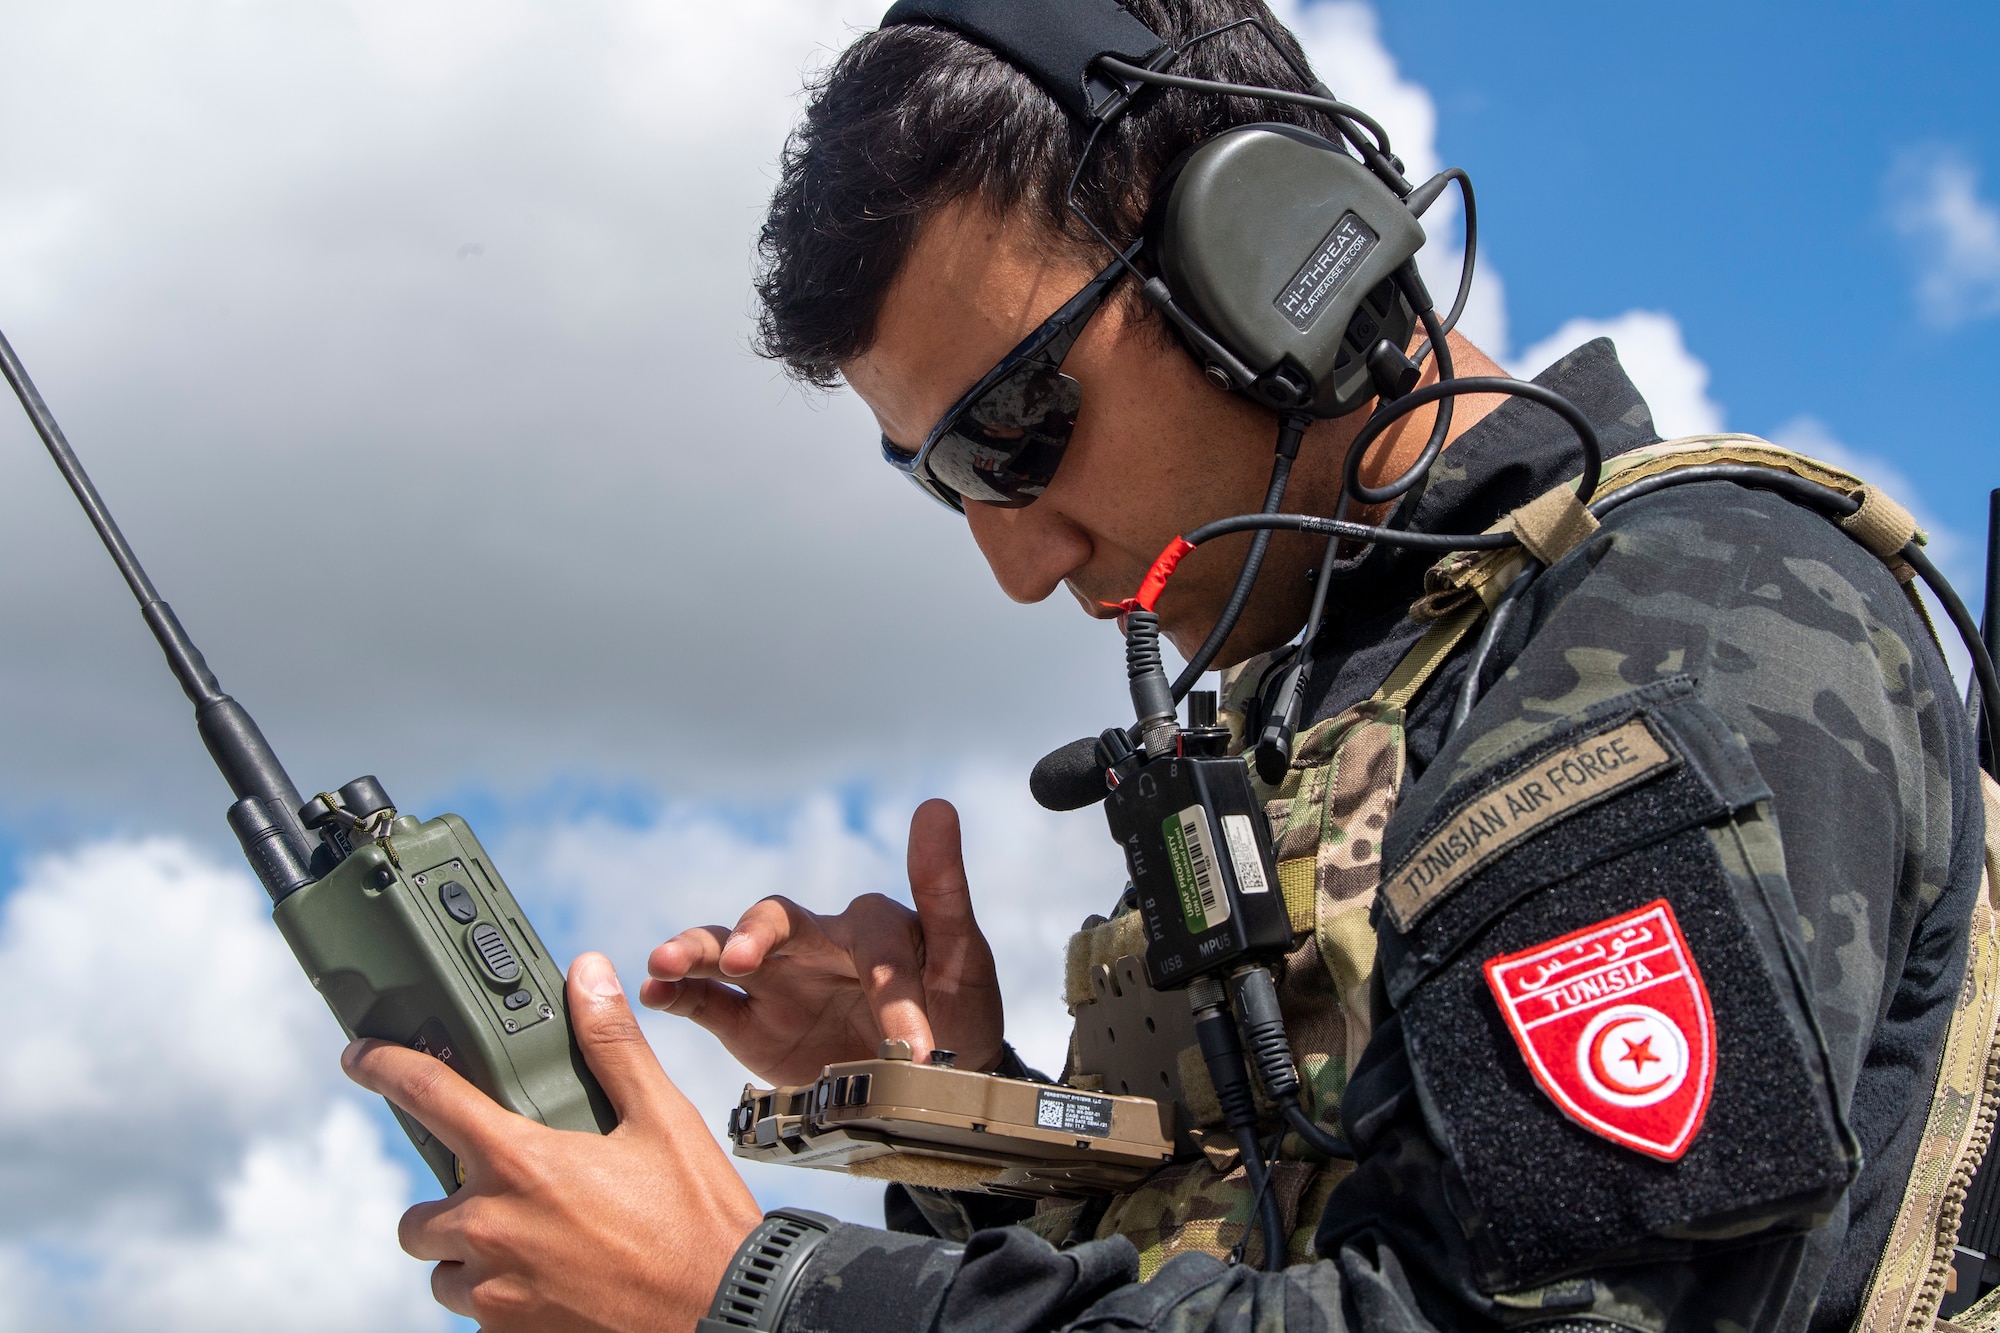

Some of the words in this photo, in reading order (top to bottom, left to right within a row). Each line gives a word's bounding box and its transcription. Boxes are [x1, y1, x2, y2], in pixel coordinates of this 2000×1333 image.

[1295, 236, 1367, 320] TEAHEADSETS.COM
[1170, 764, 1178, 778] B
[1116, 794, 1125, 806] A
[1402, 804, 1508, 897] TUNISIAN
[1505, 781, 1552, 821] AIR
[1547, 738, 1638, 796] FORCE
[1175, 826, 1186, 849] Asset
[1167, 834, 1187, 888] PROPERTY
[1181, 851, 1193, 882] Tracked
[1180, 888, 1194, 917] USAF
[1189, 883, 1198, 898] Lab
[1194, 898, 1203, 918] TDN
[1199, 932, 1231, 957] MPU5
[1160, 954, 1183, 975] USB
[1542, 960, 1653, 1011] TUNISIA
